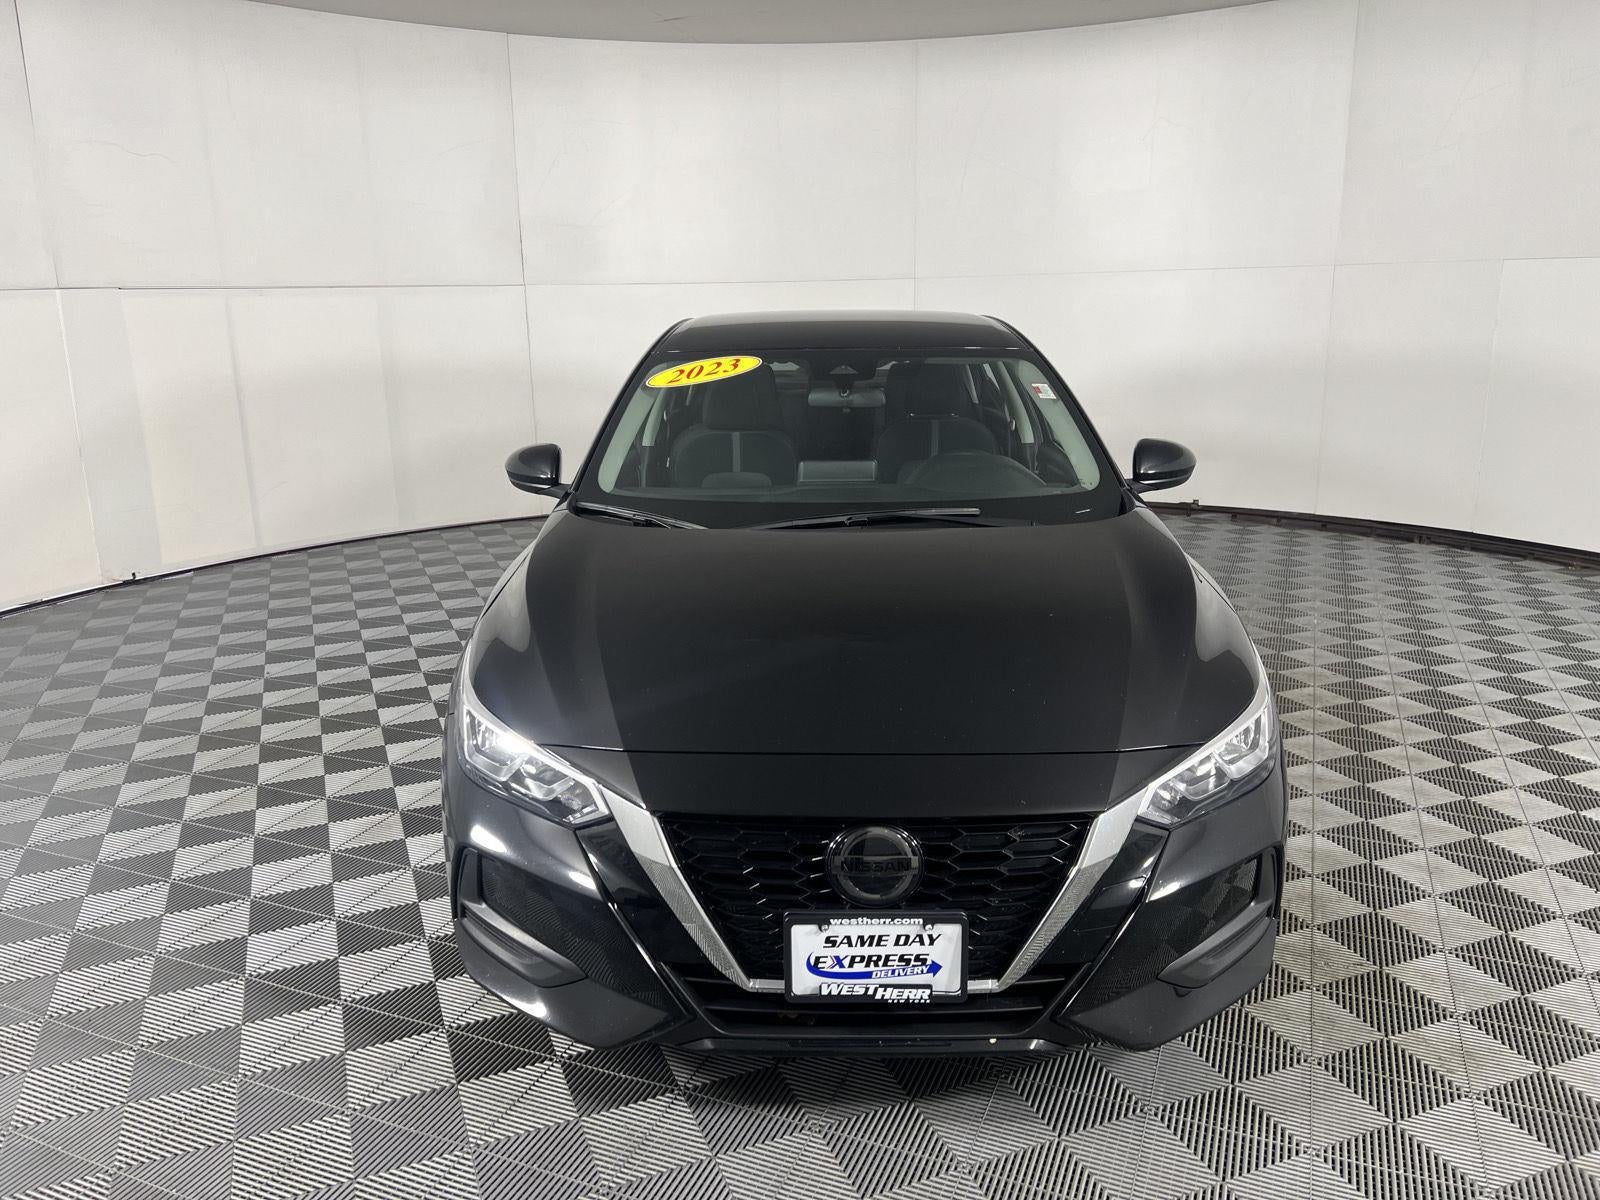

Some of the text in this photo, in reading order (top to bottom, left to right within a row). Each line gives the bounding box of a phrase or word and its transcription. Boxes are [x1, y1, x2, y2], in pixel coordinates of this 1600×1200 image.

[667, 358, 741, 384] 2023
[840, 861, 911, 873] NISSAN
[830, 917, 924, 925] westherr.com
[823, 933, 942, 949] SAME DAY
[812, 953, 930, 970] EXPRESS
[872, 964, 930, 979] DELIVERY
